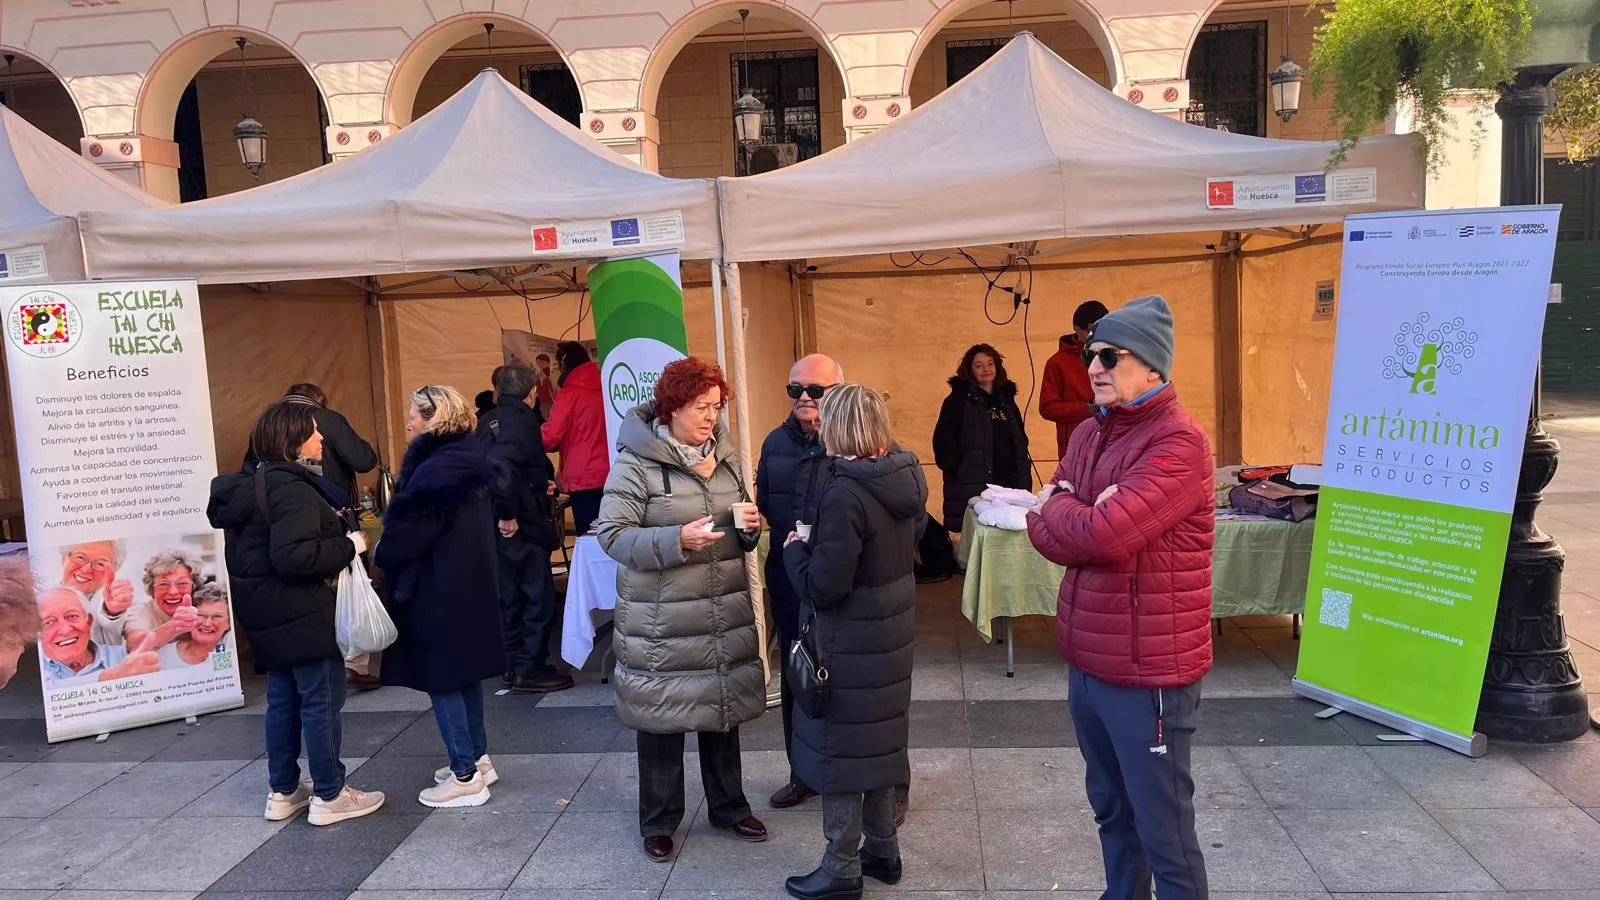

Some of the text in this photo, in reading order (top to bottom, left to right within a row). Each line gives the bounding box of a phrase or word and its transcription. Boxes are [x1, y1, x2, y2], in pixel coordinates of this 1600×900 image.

[1238, 184, 1290, 192] Ayuntamiento
[98, 289, 183, 311] ESCUELA
[110, 312, 176, 334] TAI CHI
[108, 334, 183, 356] HUESCA
[67, 365, 149, 380] Beneficios
[36, 395, 82, 404] Disminuye
[100, 392, 132, 400] dolores
[613, 384, 636, 401] ARO
[42, 410, 73, 418] Mejora
[48, 422, 72, 431] Alivio
[99, 419, 125, 427] artritis
[1340, 408, 1500, 450] artánima
[41, 437, 87, 445] Disminuye
[74, 448, 104, 457] Mejora
[1338, 444, 1493, 473] SERVICIOS
[30, 465, 70, 474] Aumenta
[83, 460, 127, 470] capacidad
[42, 478, 71, 488] Ayuda
[81, 474, 122, 483] coordinar
[1336, 463, 1490, 493] PRODUCTOS
[56, 490, 98, 499] Favorece
[106, 499, 136, 508] calidad
[44, 519, 84, 528] Aumenta
[97, 512, 142, 522] elasticidad
[1448, 522, 1484, 532] productos
[1451, 531, 1482, 541] personas
[1420, 629, 1464, 648] artanima.org
[51, 691, 84, 702] ESCUELA
[116, 680, 144, 691] HUESCA
